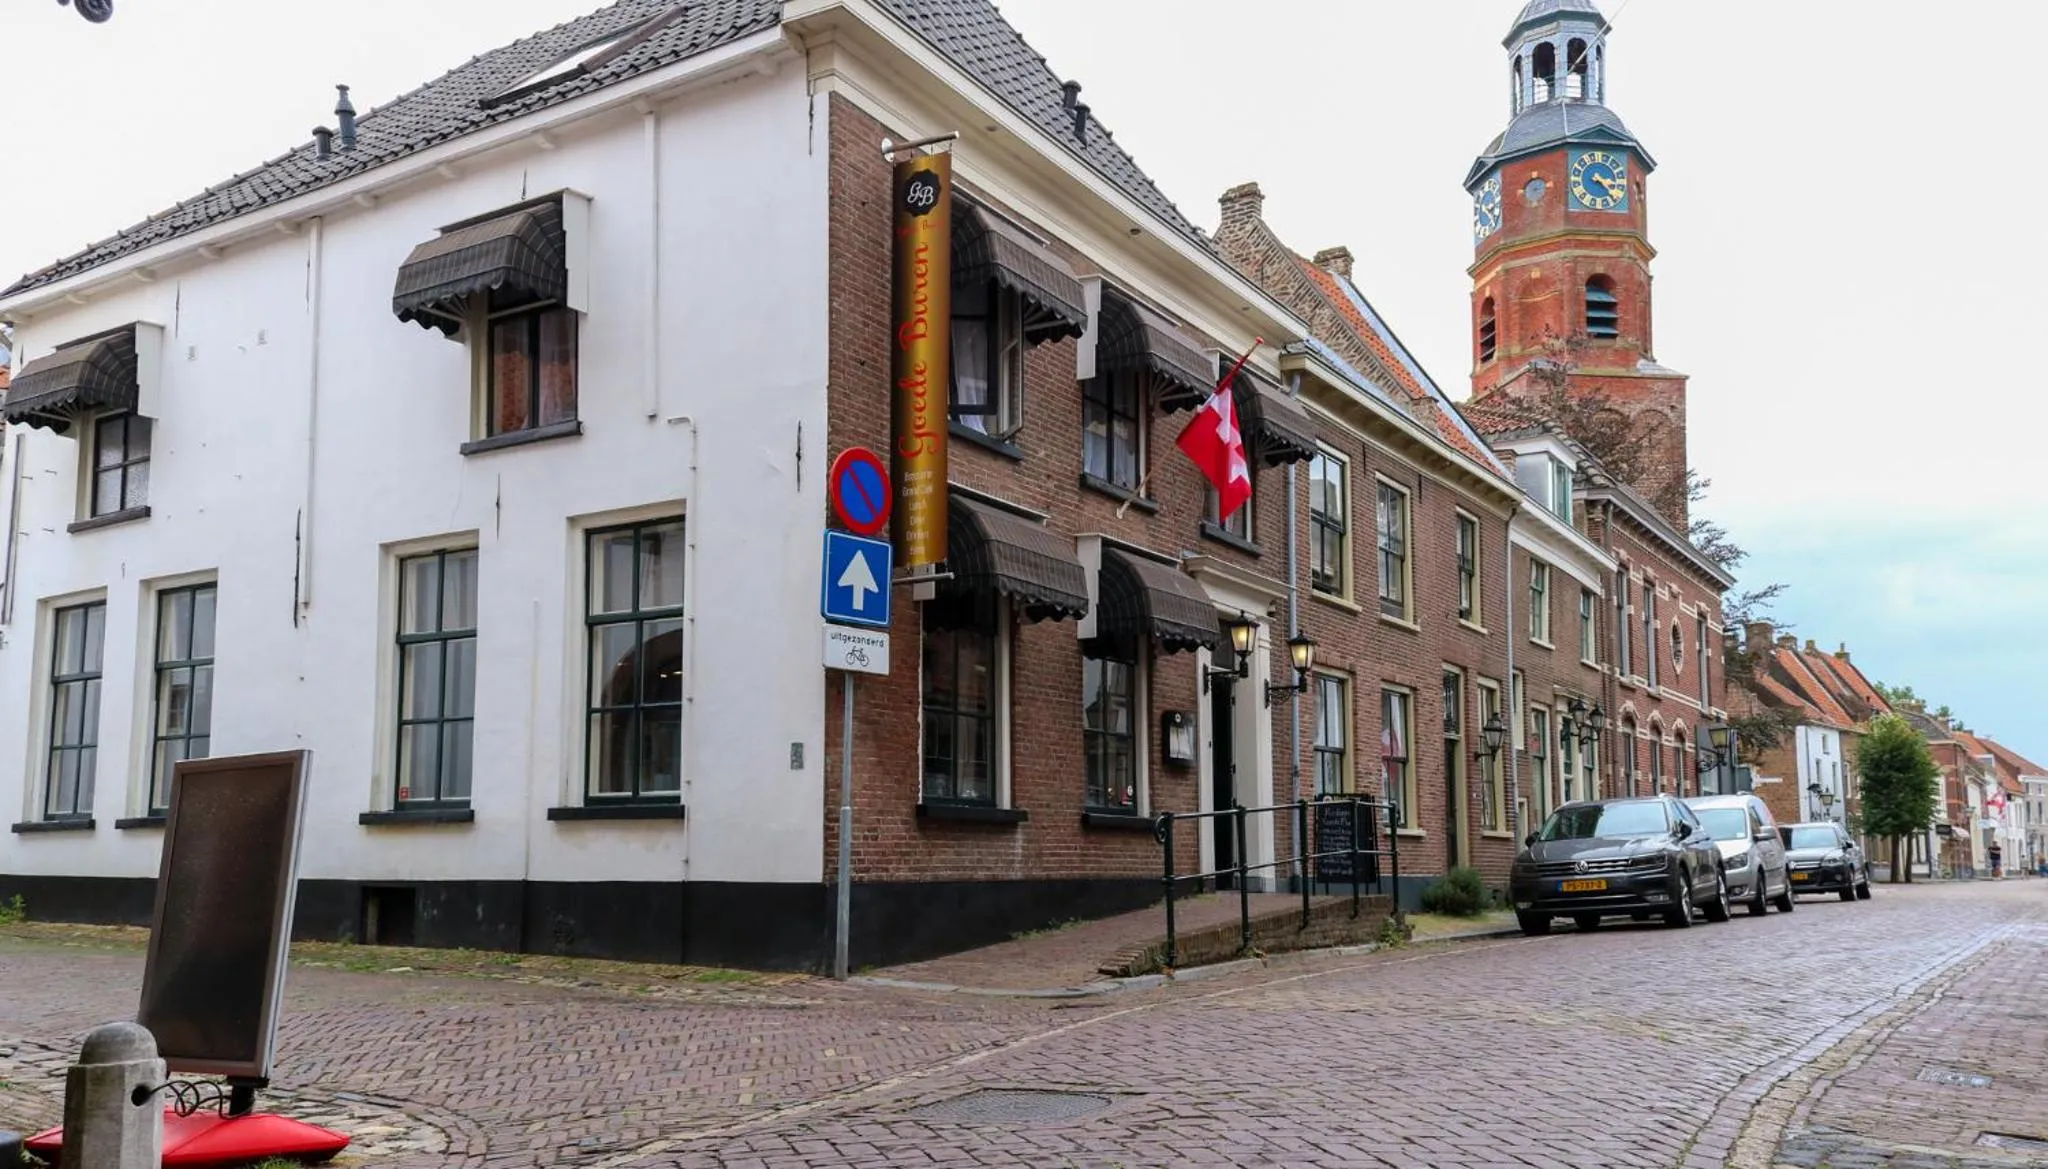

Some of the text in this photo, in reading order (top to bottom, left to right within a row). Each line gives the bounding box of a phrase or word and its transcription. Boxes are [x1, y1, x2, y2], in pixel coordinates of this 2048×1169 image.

[907, 181, 934, 206] GB
[898, 242, 929, 351] Buren
[898, 361, 942, 458] Goede
[831, 632, 885, 648] uitgezonderd
